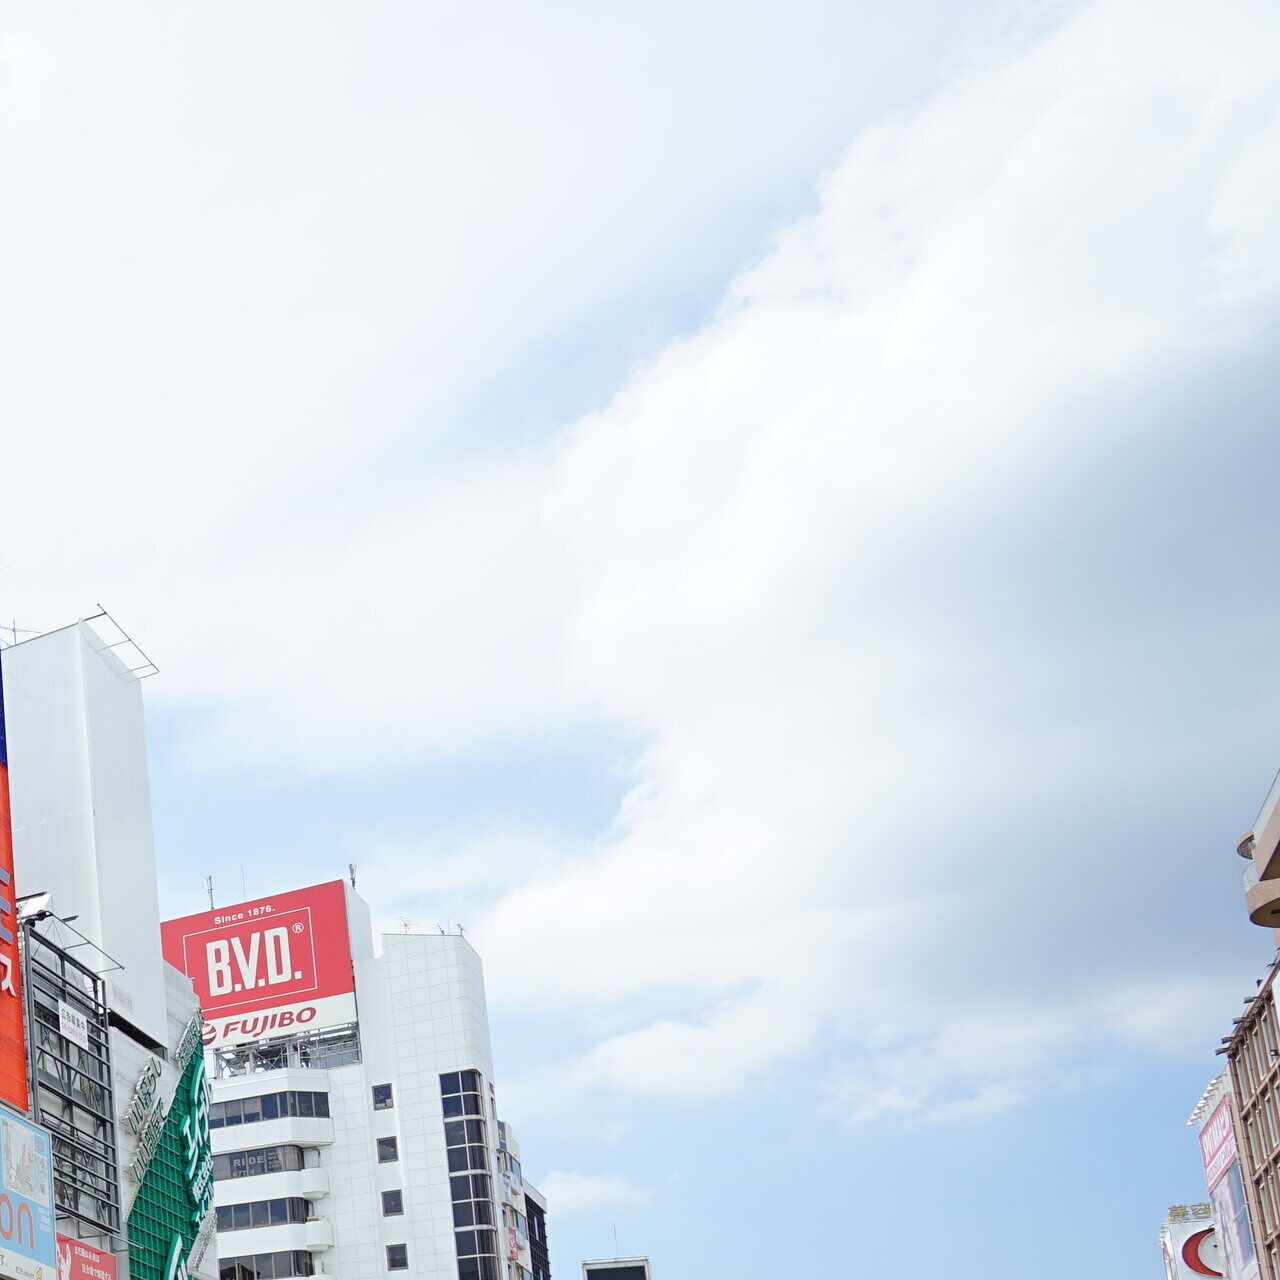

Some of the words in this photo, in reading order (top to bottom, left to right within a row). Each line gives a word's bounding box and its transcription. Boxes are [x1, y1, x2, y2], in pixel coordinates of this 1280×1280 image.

[214, 911, 244, 925] Since
[246, 904, 276, 918] 1876.
[205, 925, 303, 997] B.V.D.
[221, 1006, 317, 1038] FUJIBO
